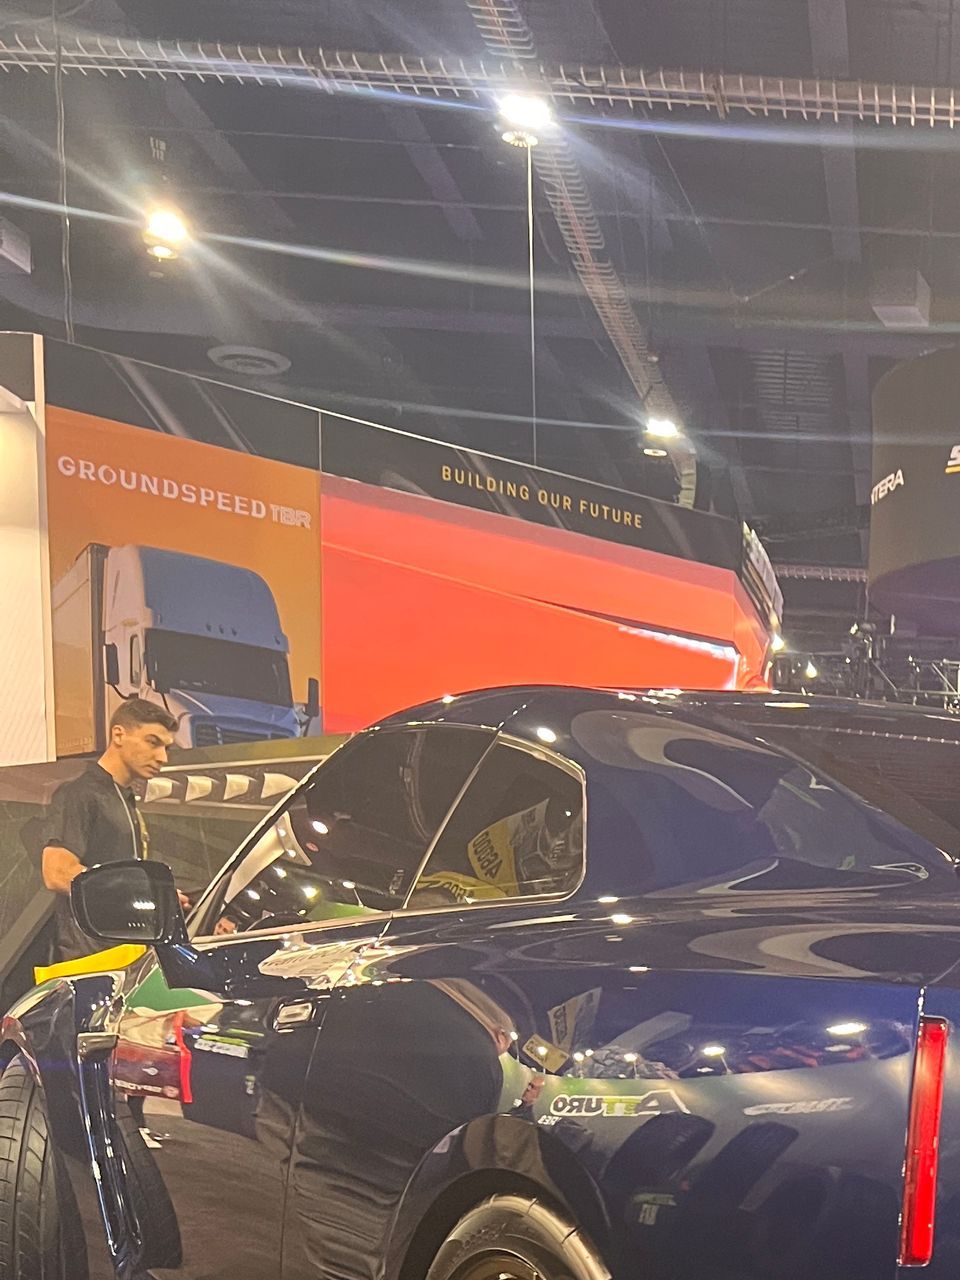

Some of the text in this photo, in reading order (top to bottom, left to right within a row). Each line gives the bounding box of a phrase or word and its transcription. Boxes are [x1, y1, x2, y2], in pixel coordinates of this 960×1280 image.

[57, 455, 312, 529] GROUNDSPEED TBR
[441, 465, 643, 529] BUILDING OUR FUTURE
[871, 468, 905, 505] TERA
